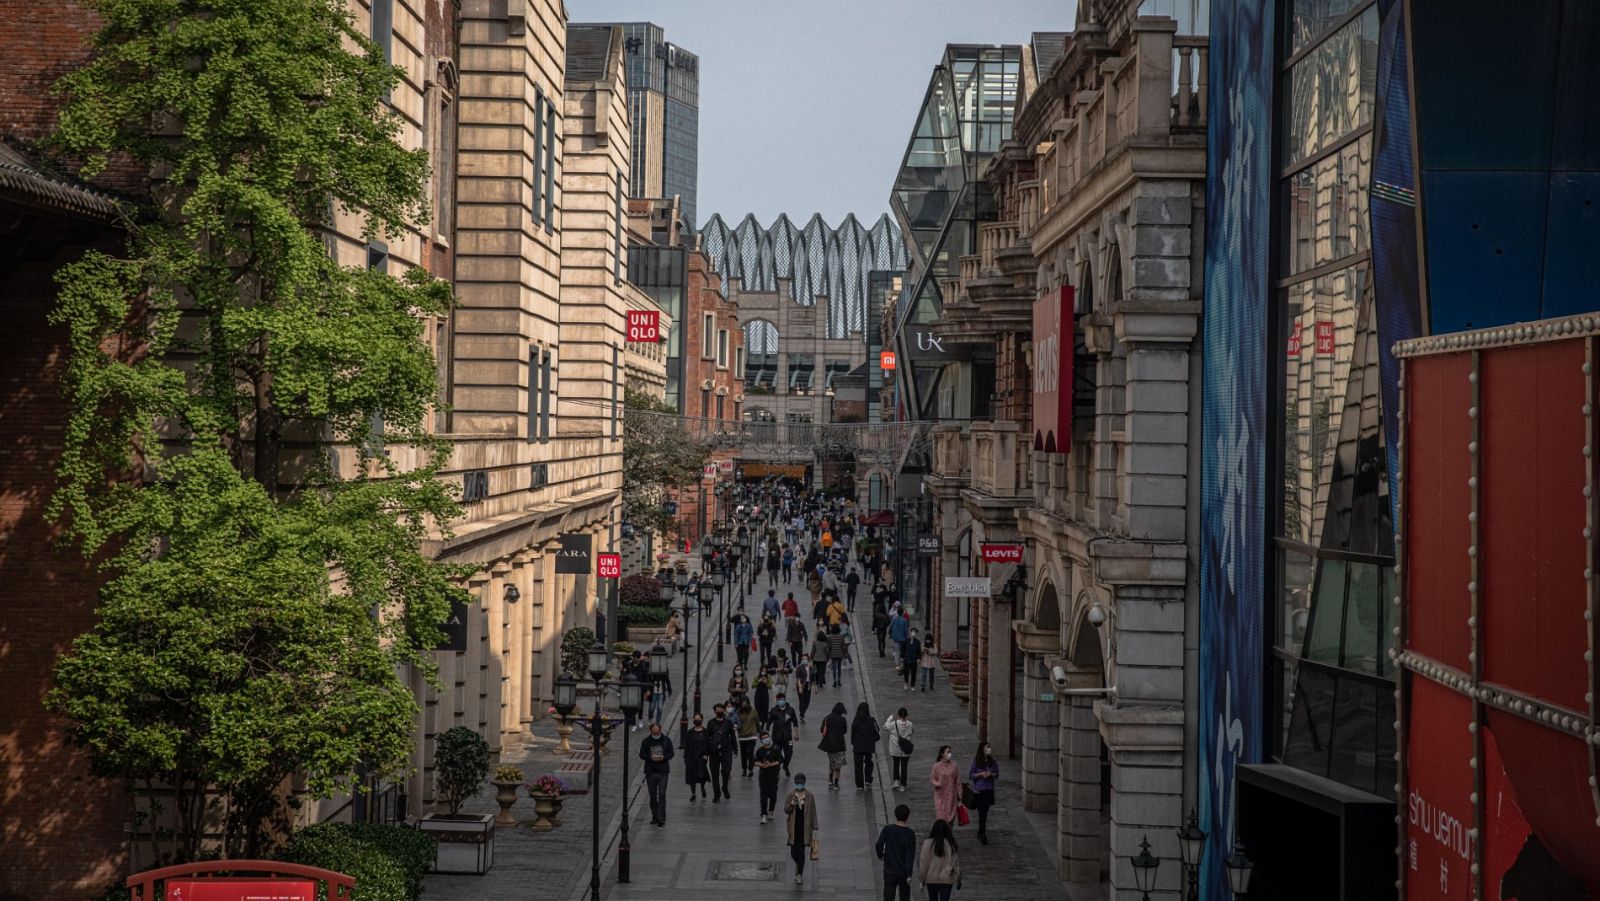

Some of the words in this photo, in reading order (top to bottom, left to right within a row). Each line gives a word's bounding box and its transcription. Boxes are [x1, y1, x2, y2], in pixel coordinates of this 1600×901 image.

[631, 314, 654, 325] UNI
[630, 327, 655, 339] QLO
[919, 538, 939, 548] P&B
[600, 557, 617, 566] UNI
[600, 567, 618, 576] QLO
[1409, 788, 1431, 834] shu
[1432, 806, 1474, 861] uemur
